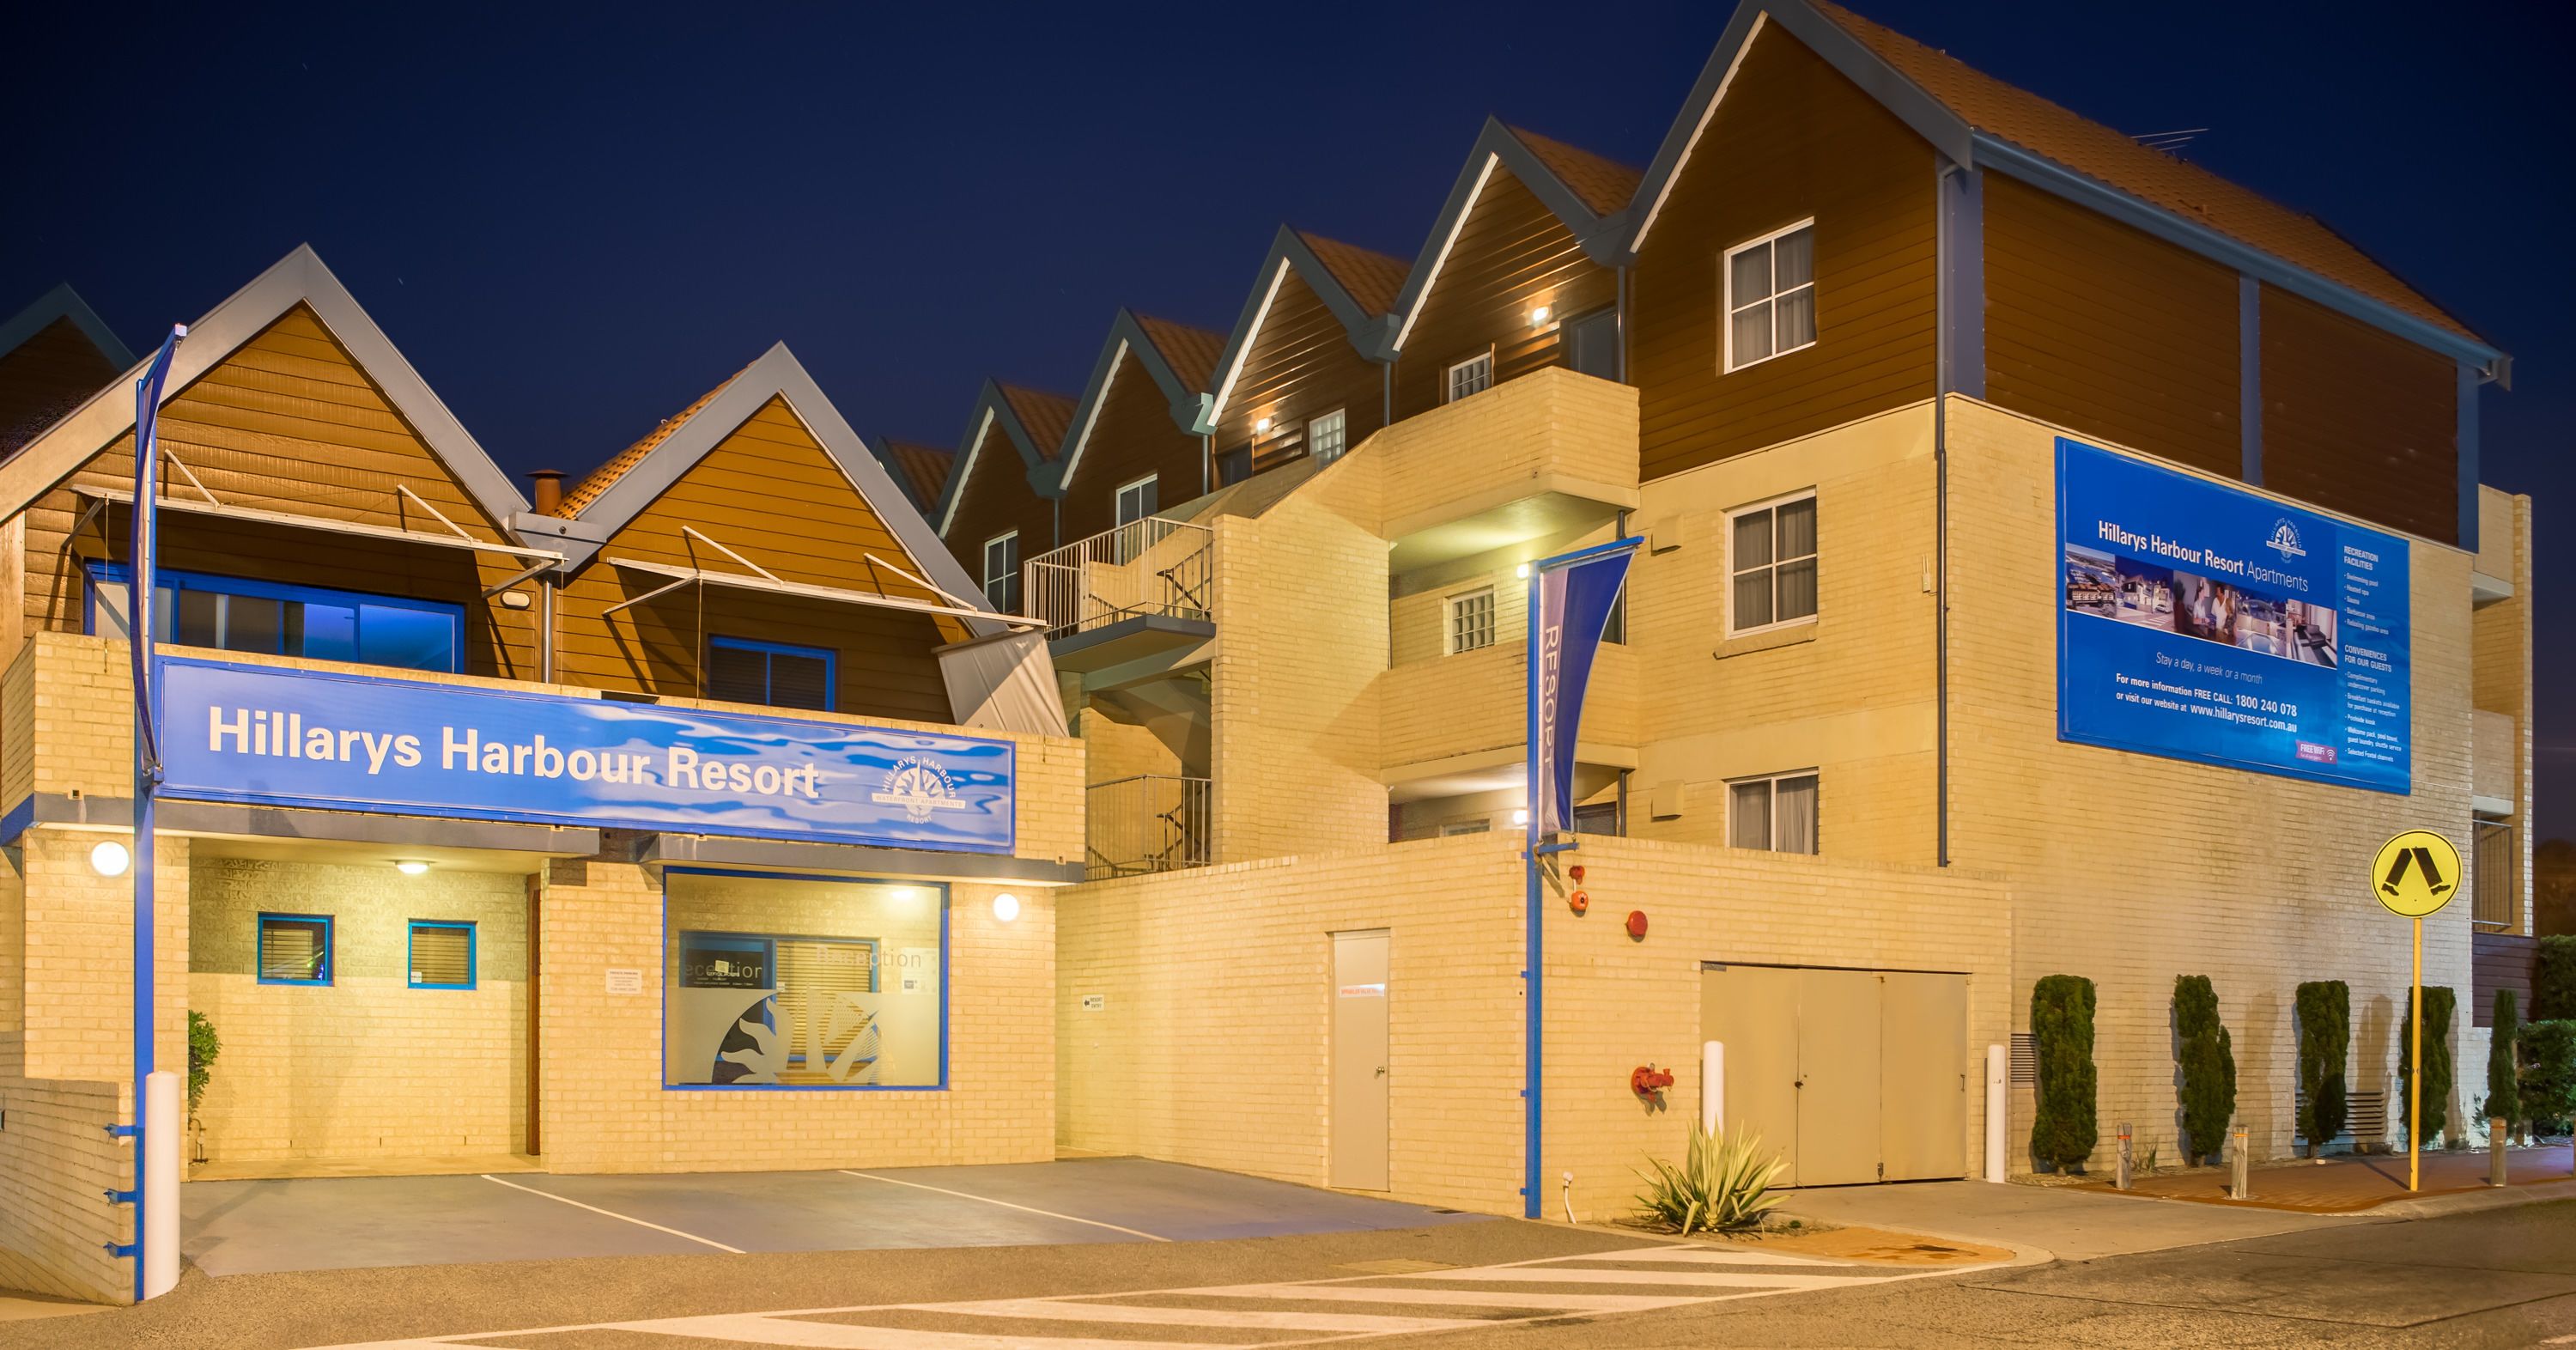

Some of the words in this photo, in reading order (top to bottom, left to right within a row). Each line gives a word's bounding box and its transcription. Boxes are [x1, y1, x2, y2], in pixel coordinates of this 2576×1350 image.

[2099, 520, 2147, 551] Hillarys
[2151, 534, 2201, 563] Harbour
[2204, 549, 2244, 575] Resort
[2246, 560, 2309, 592] Apartments
[2344, 545, 2379, 562] RECREATION
[2344, 556, 2373, 571] FACILITIES
[2345, 644, 2387, 661] CONVENIENCES
[2345, 655, 2356, 664] FOR
[2357, 658, 2369, 667] OUR
[2370, 660, 2392, 672] GUESTS
[2156, 652, 2172, 668] Stay
[2174, 659, 2179, 667] a
[2197, 663, 2202, 672] a
[2203, 665, 2223, 677] week
[2225, 669, 2234, 679] or
[2240, 673, 2263, 685] month
[1544, 624, 1559, 770] RESORT
[2116, 672, 2129, 684] For
[2130, 676, 2150, 688] more
[2152, 680, 2192, 697] information
[2194, 688, 2212, 701] FREE
[2235, 694, 2258, 709] 1800
[2261, 699, 2277, 714] 240
[2281, 702, 2297, 717] 078
[2125, 692, 2140, 703] visit
[2141, 696, 2153, 706] our
[2154, 696, 2179, 711] website
[2180, 702, 2187, 712] at
[2190, 703, 2297, 733] www.hillarysresort.com.au
[210, 705, 422, 775] Hillarys
[442, 727, 650, 785] Harbour
[668, 746, 820, 799] Resort
[2300, 744, 2313, 753] FREE
[883, 756, 916, 792] HILLARYS
[922, 757, 956, 798] HARBOUR
[876, 795, 919, 804] WATERFRONT
[920, 798, 963, 807] APARTMENTS
[907, 814, 932, 824] RESORT
